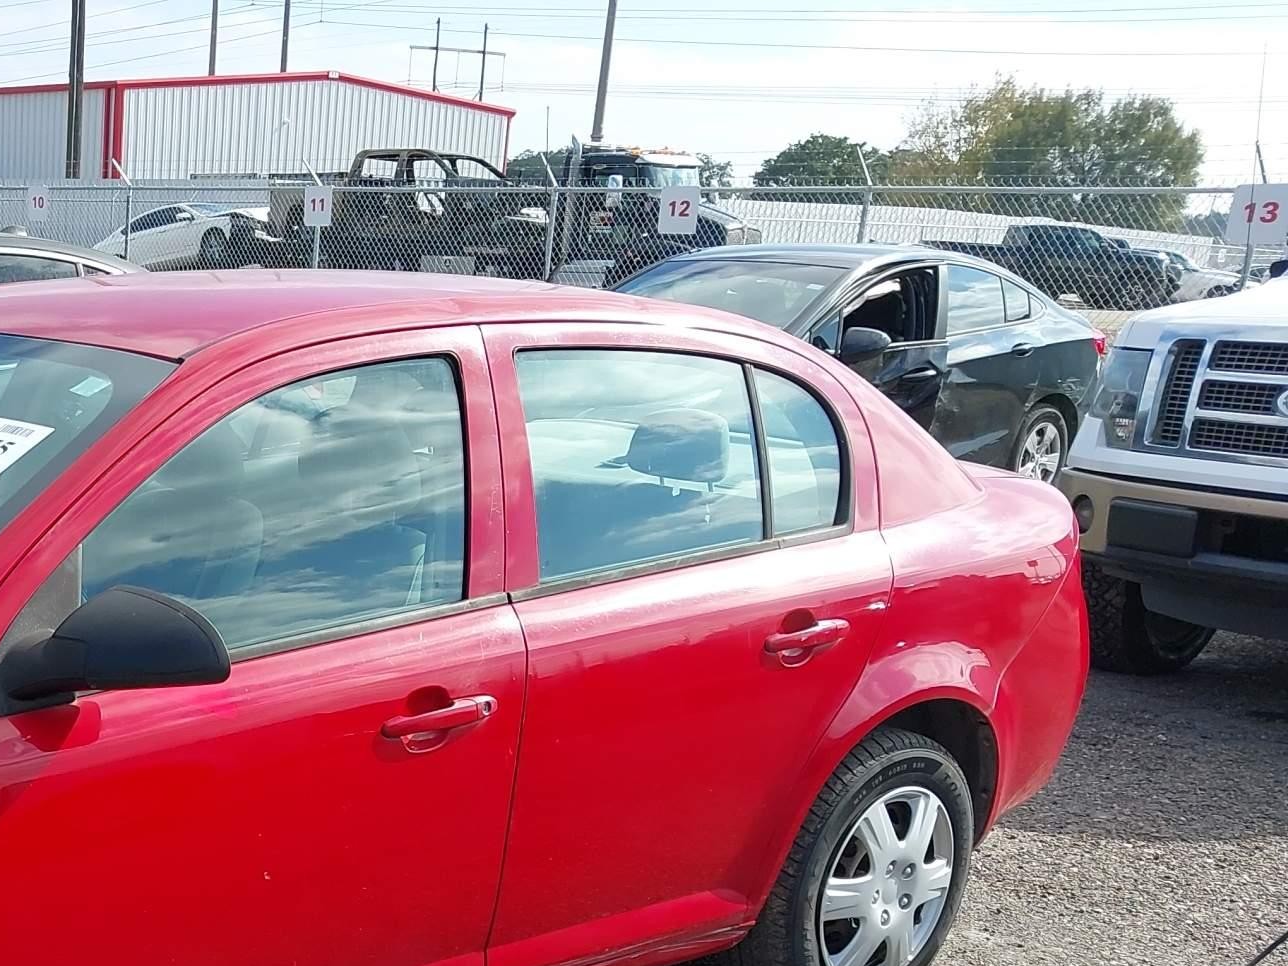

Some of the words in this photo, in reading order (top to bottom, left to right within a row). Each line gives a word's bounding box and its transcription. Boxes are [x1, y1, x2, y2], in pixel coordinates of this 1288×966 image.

[32, 196, 44, 209] 10
[310, 198, 325, 212] 11
[668, 200, 691, 217] 12
[1244, 201, 1279, 223] 13
